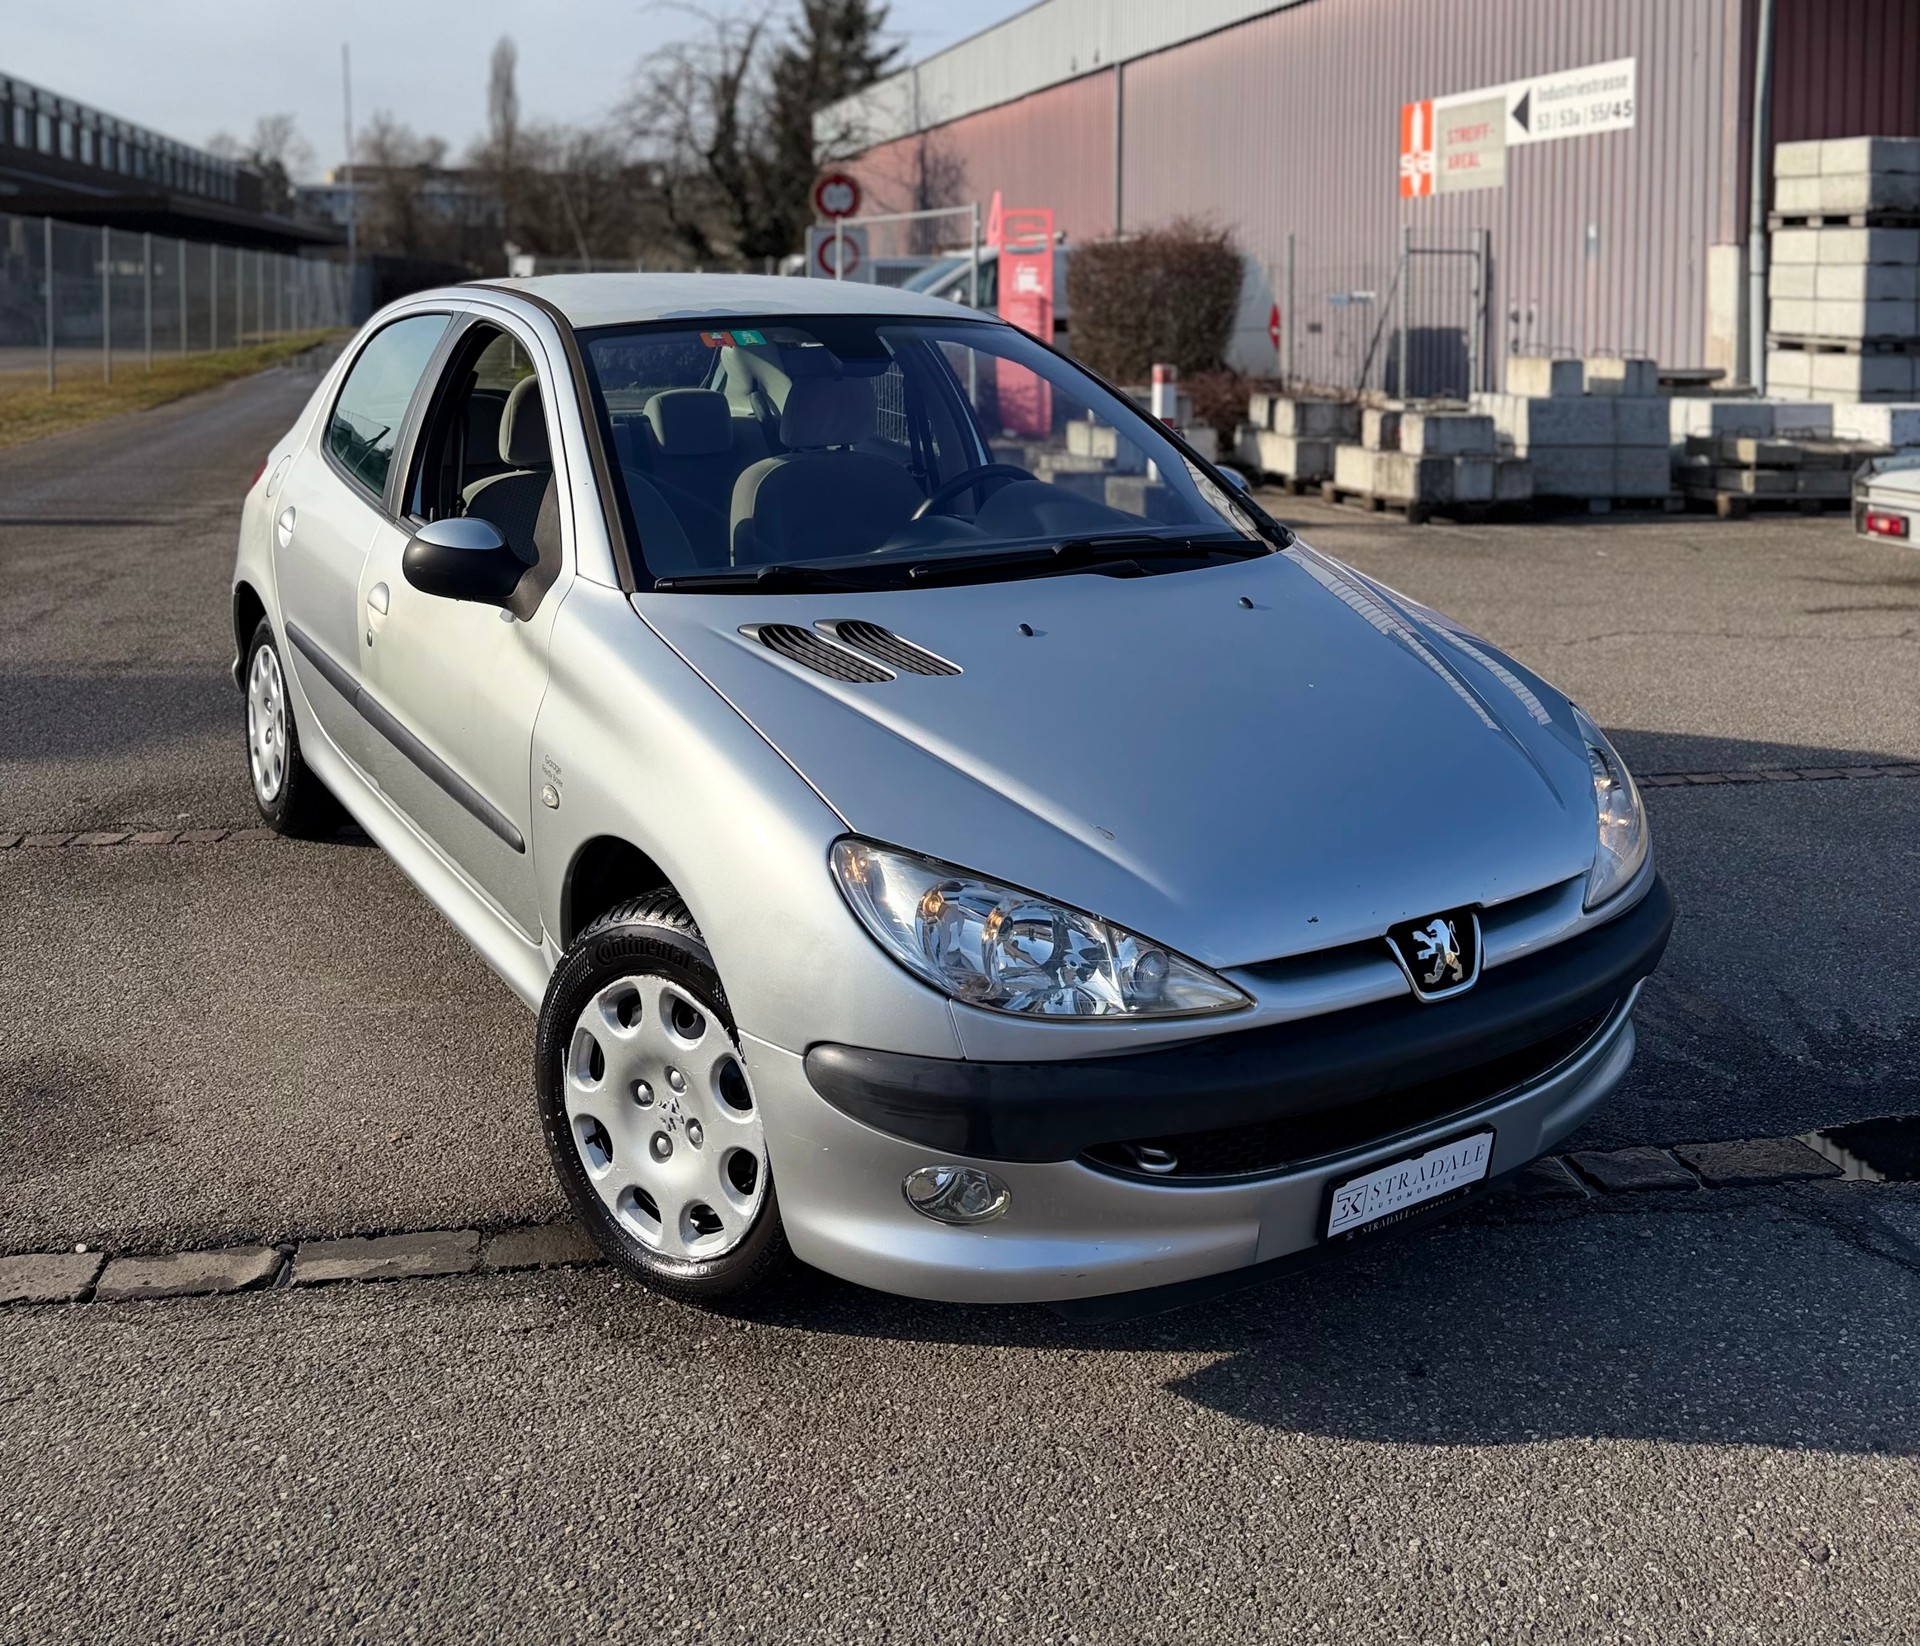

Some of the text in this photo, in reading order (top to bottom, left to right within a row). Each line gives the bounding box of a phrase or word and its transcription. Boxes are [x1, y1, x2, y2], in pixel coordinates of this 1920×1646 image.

[1537, 75, 1628, 103] Industriestrasse
[595, 933, 691, 970] Continental
[1370, 1143, 1485, 1201] STRADALE
[1368, 1174, 1456, 1213] AUTOMOBILE
